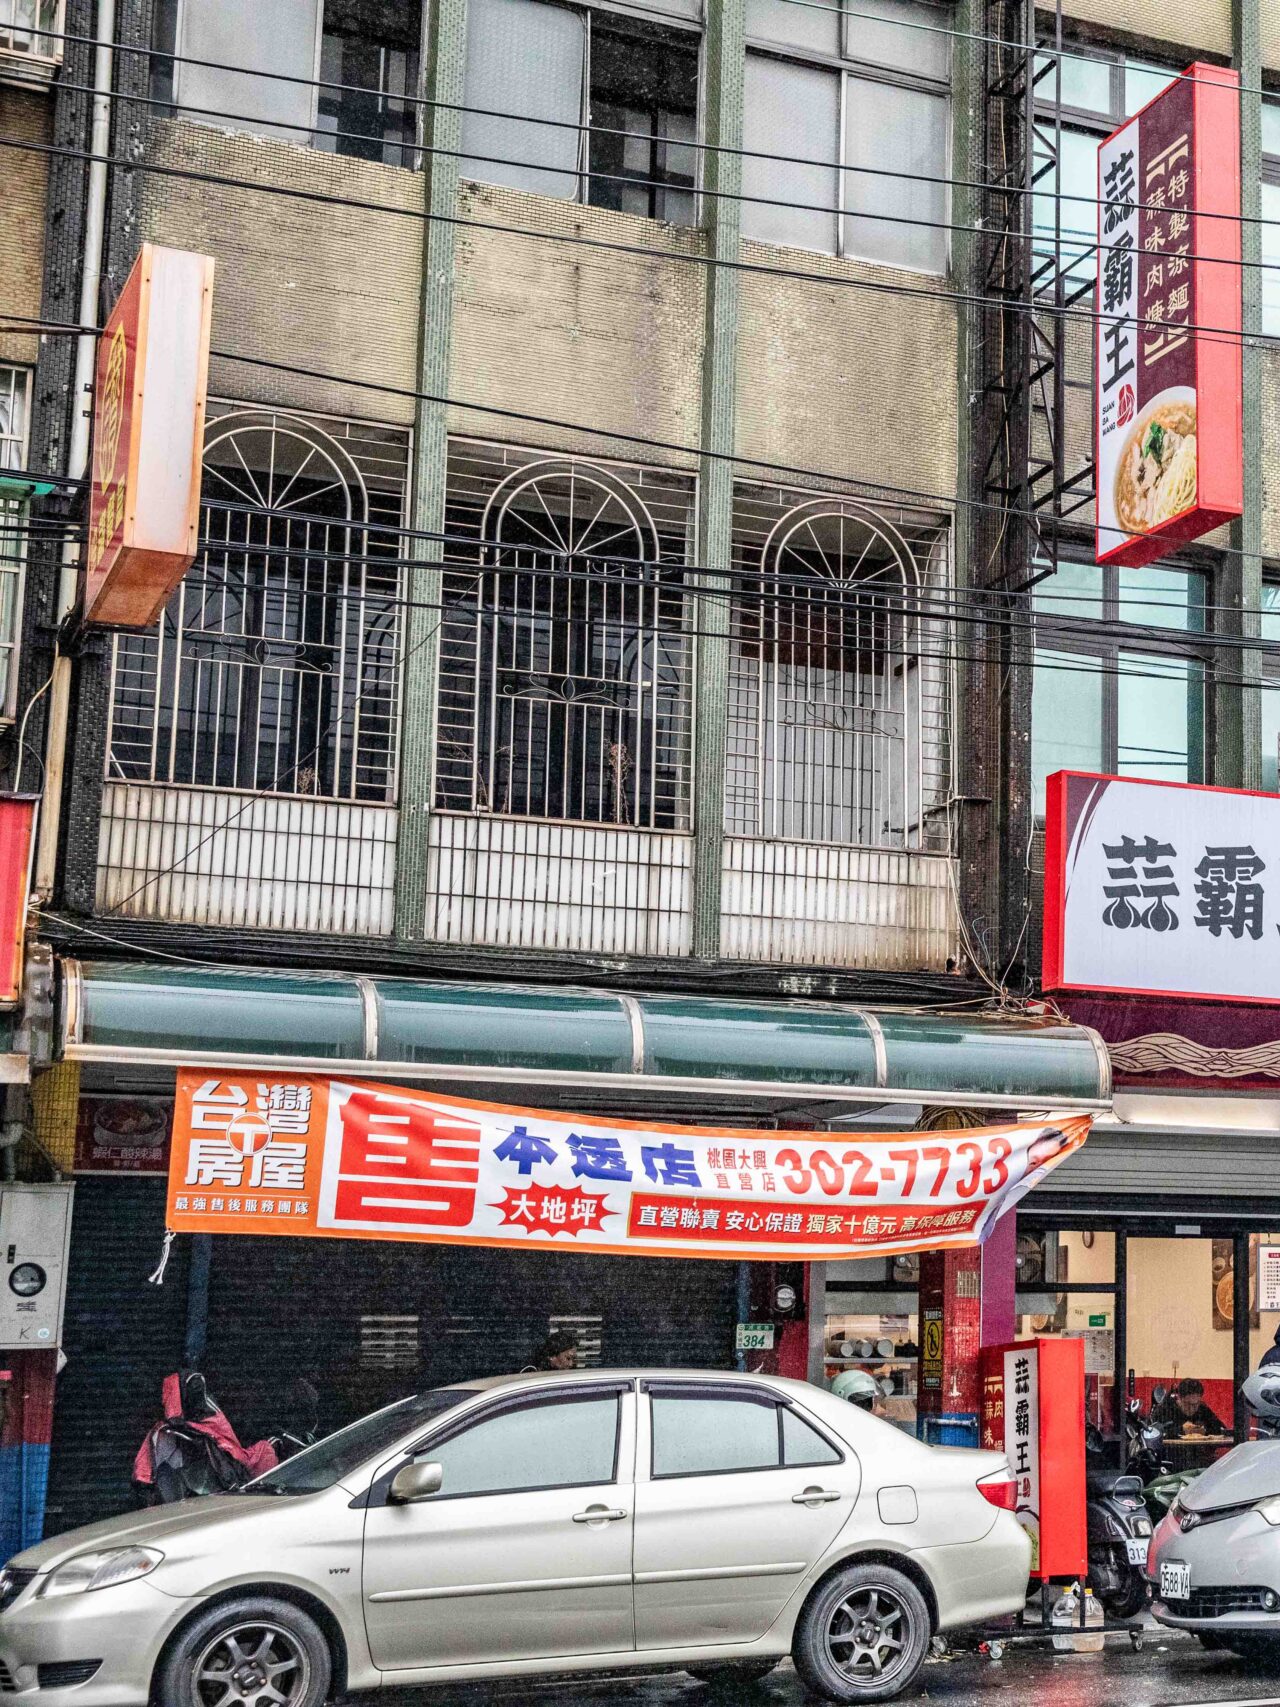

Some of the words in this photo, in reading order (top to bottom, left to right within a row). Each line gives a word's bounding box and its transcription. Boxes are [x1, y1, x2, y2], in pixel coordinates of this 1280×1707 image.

[1103, 149, 1135, 393] 蒜霸王
[190, 1080, 313, 1135] 台灣
[184, 1137, 308, 1190] 房屋
[334, 1091, 482, 1228] 售
[493, 1125, 703, 1188] 本透店
[707, 1147, 768, 1169] 桃園大興
[716, 1172, 776, 1192] 直營店
[774, 1137, 1013, 1198] 302-7733
[175, 1196, 310, 1216] 最強售後服務團隊
[511, 1193, 599, 1227] 大地坪
[637, 1205, 720, 1231] 直營聯賣
[725, 1212, 804, 1235] 安心保證
[806, 1214, 897, 1235] 獨家十億元
[743, 1334, 766, 1348] 384
[1015, 1357, 1031, 1475] 蒜霸王
